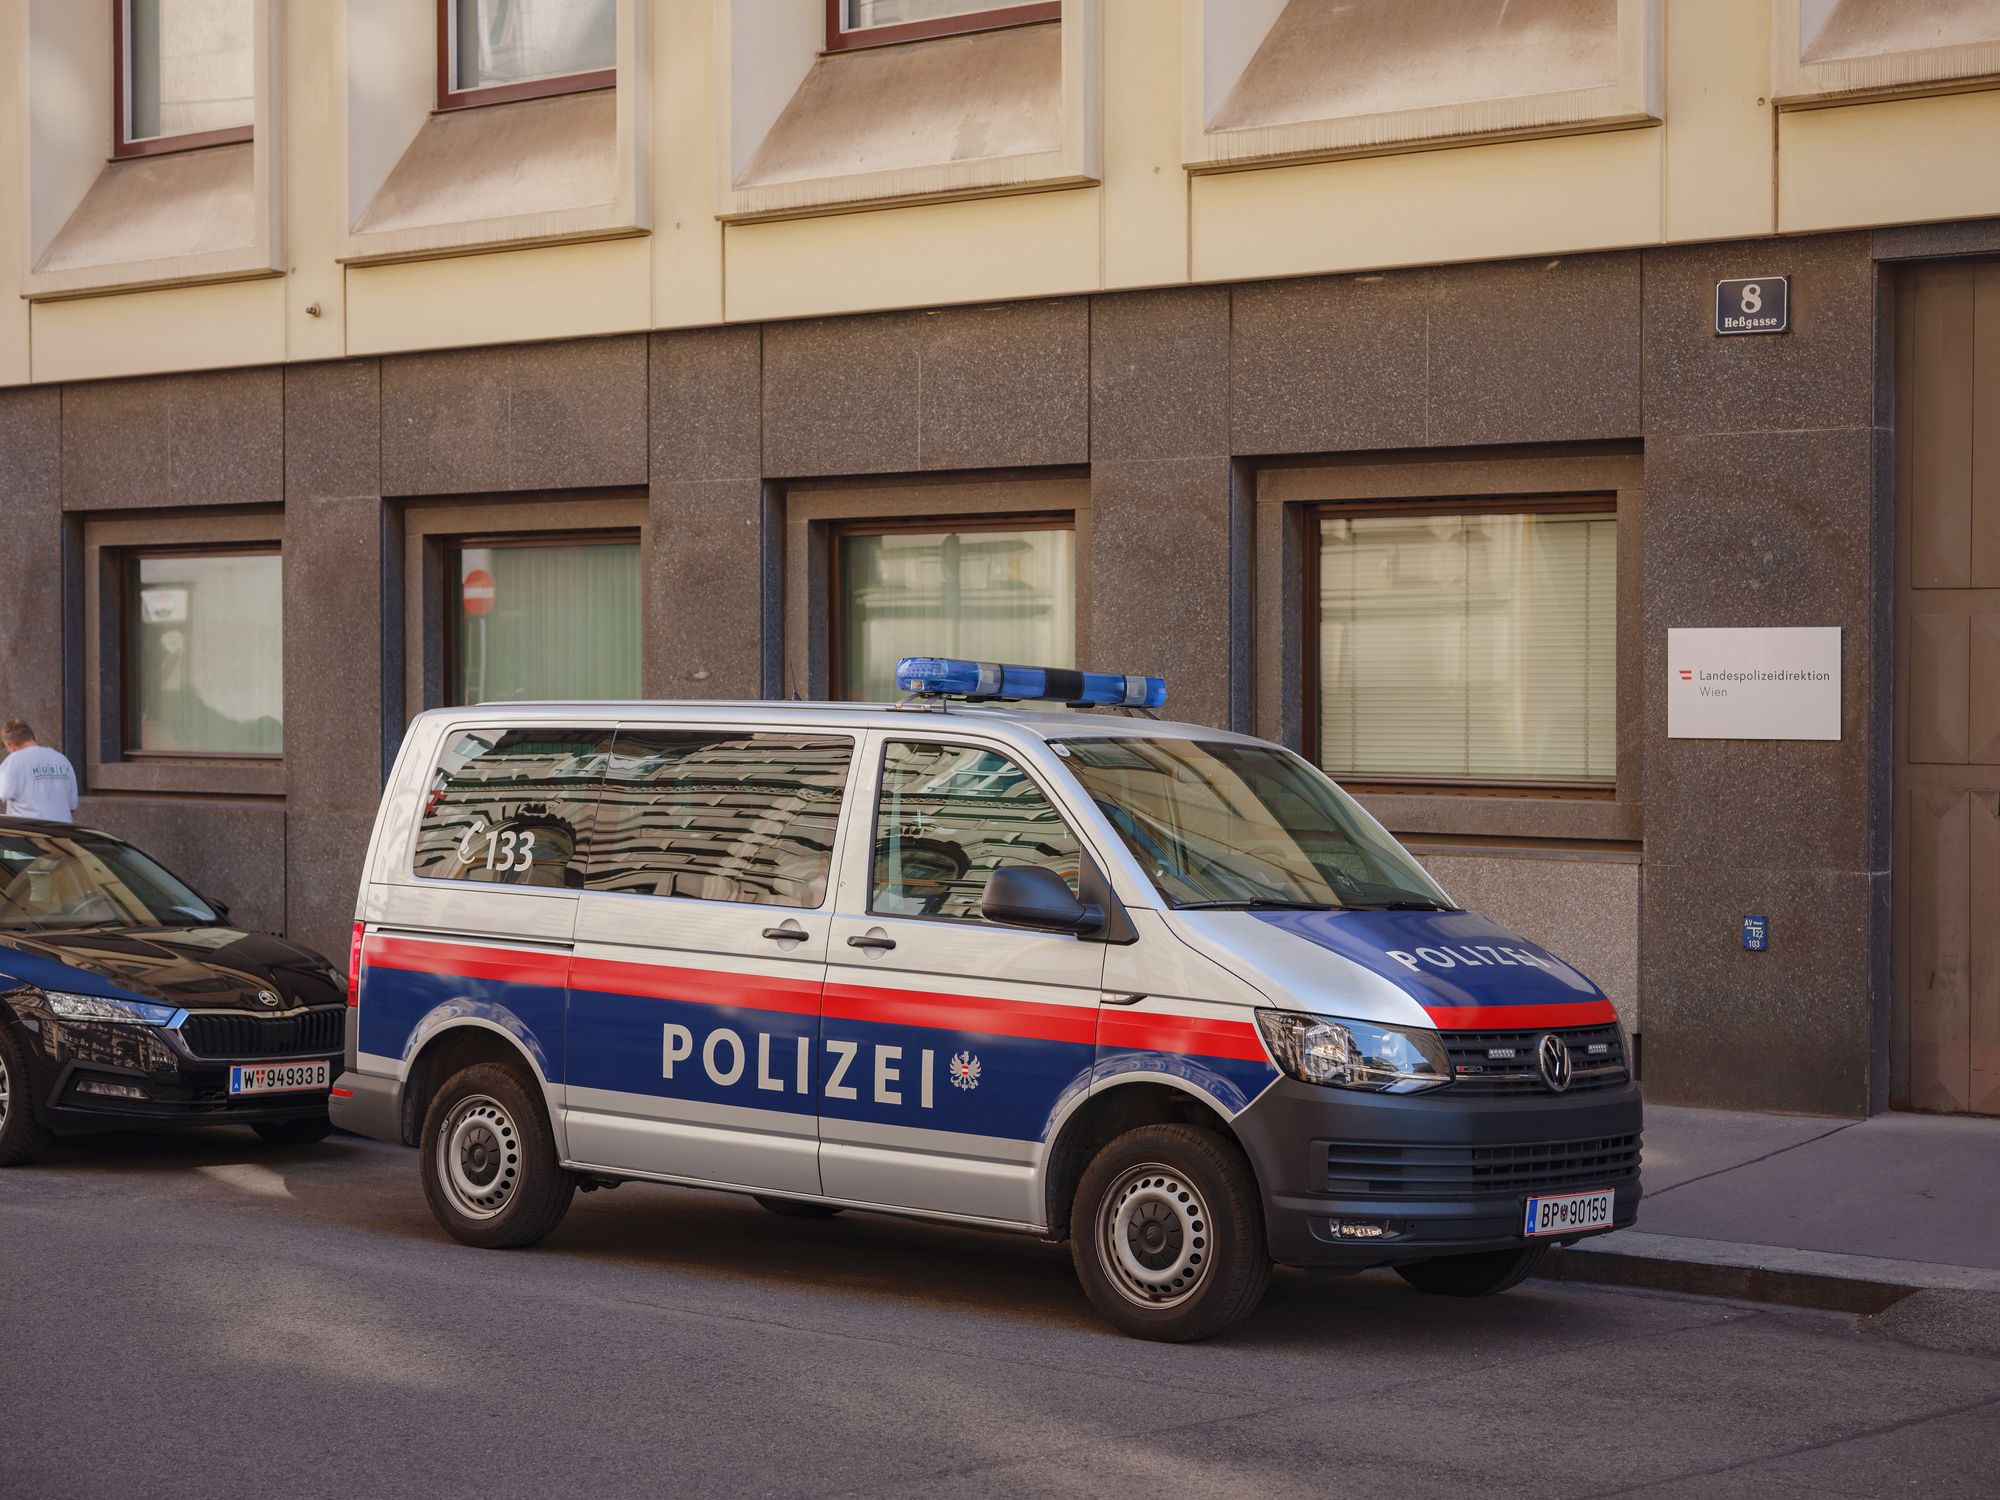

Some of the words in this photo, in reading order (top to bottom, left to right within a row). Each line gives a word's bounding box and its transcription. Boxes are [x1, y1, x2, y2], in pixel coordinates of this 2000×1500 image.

[1741, 284, 1762, 314] 8
[1724, 316, 1778, 329] Heßgasse
[1699, 669, 1831, 683] Landespolizeidirektion
[1699, 686, 1729, 697] Wien
[486, 830, 535, 872] 133
[1385, 945, 1551, 972] POLIZEI
[244, 1070, 255, 1089] W
[267, 1067, 313, 1087] 94933
[317, 1066, 325, 1084] B
[662, 1023, 934, 1109] POLIZEI
[1541, 1203, 1560, 1228] BP
[1569, 1197, 1607, 1225] 90159
